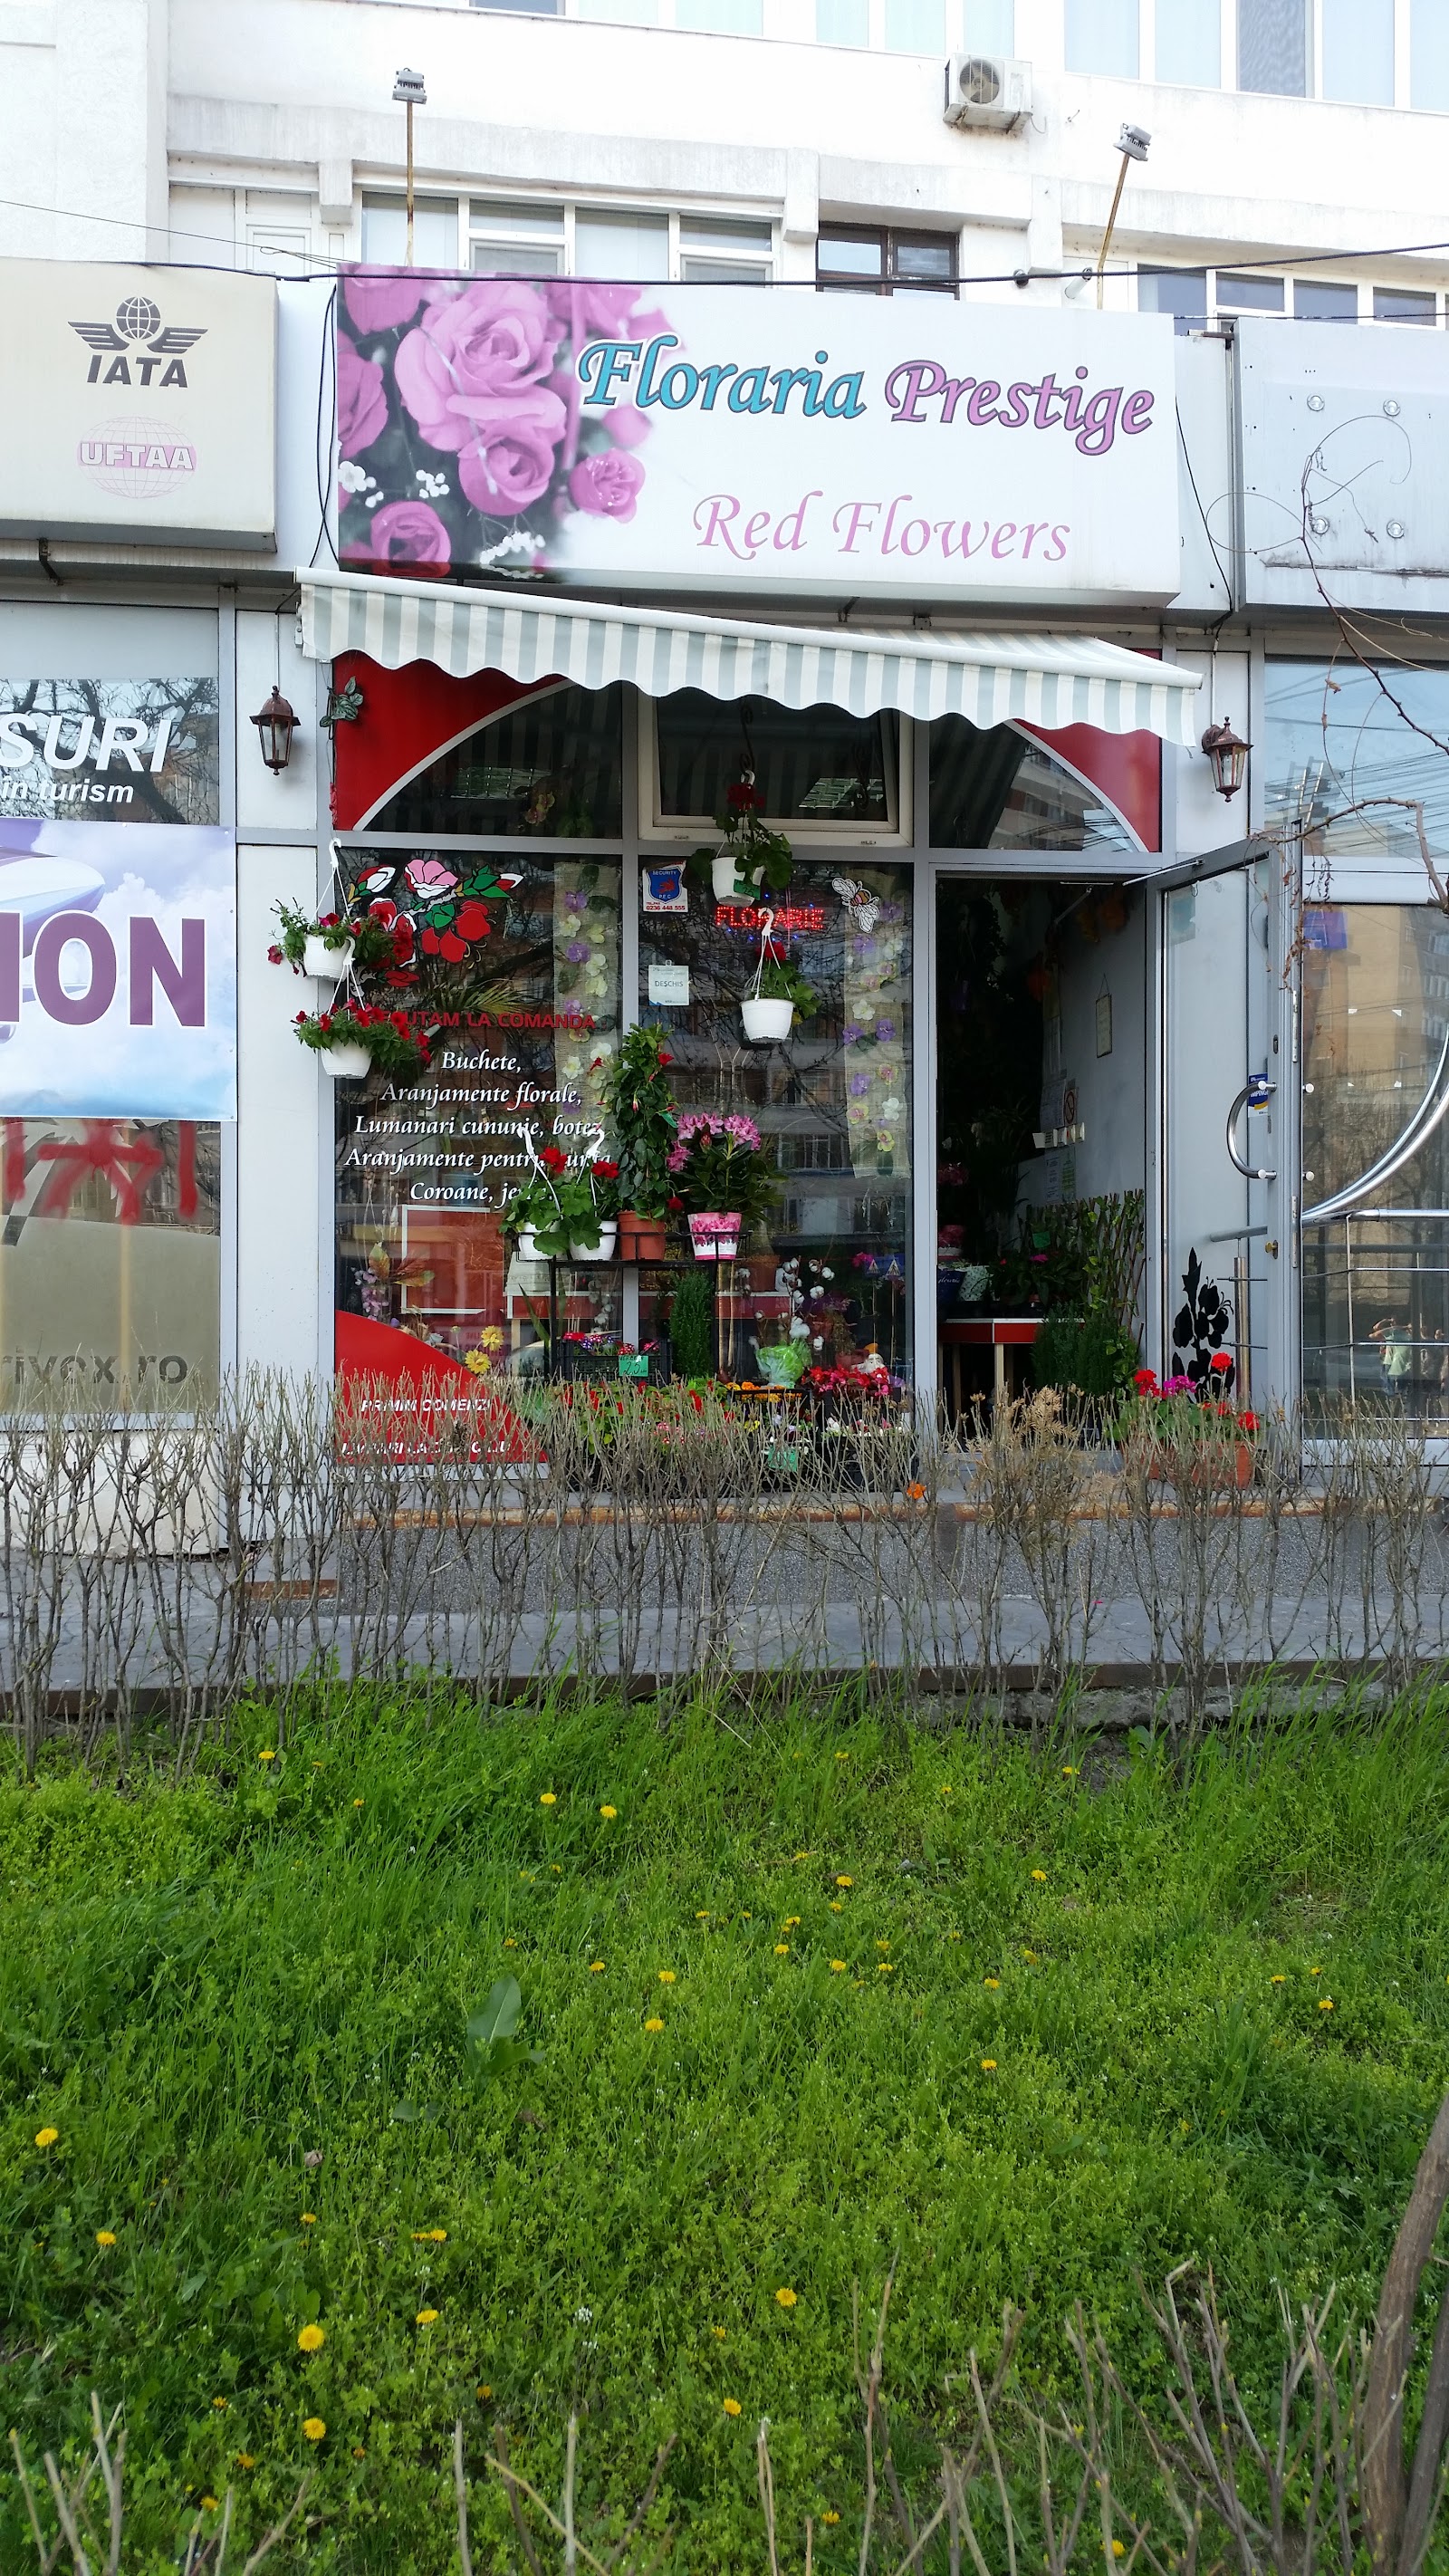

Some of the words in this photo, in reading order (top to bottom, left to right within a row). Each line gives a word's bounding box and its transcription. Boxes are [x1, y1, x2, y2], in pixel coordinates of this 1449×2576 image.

[87, 354, 188, 388] IATA
[580, 334, 867, 420] Floraria
[885, 359, 1156, 457] Prestige
[80, 442, 194, 470] UFTAA
[693, 490, 823, 561] Red
[832, 495, 1071, 562] Flowers
[0, 712, 172, 773] SURI
[40, 778, 134, 803] turism
[466, 1012, 492, 1027] LA
[441, 1049, 522, 1073] Buchete,
[379, 1083, 509, 1110] Aranjamente
[506, 1081, 582, 1111] florale,
[354, 1115, 455, 1134] Lumanari
[462, 1117, 543, 1138] cununie,
[343, 1148, 475, 1175] Aranjamente
[410, 1182, 494, 1203] Coroane,
